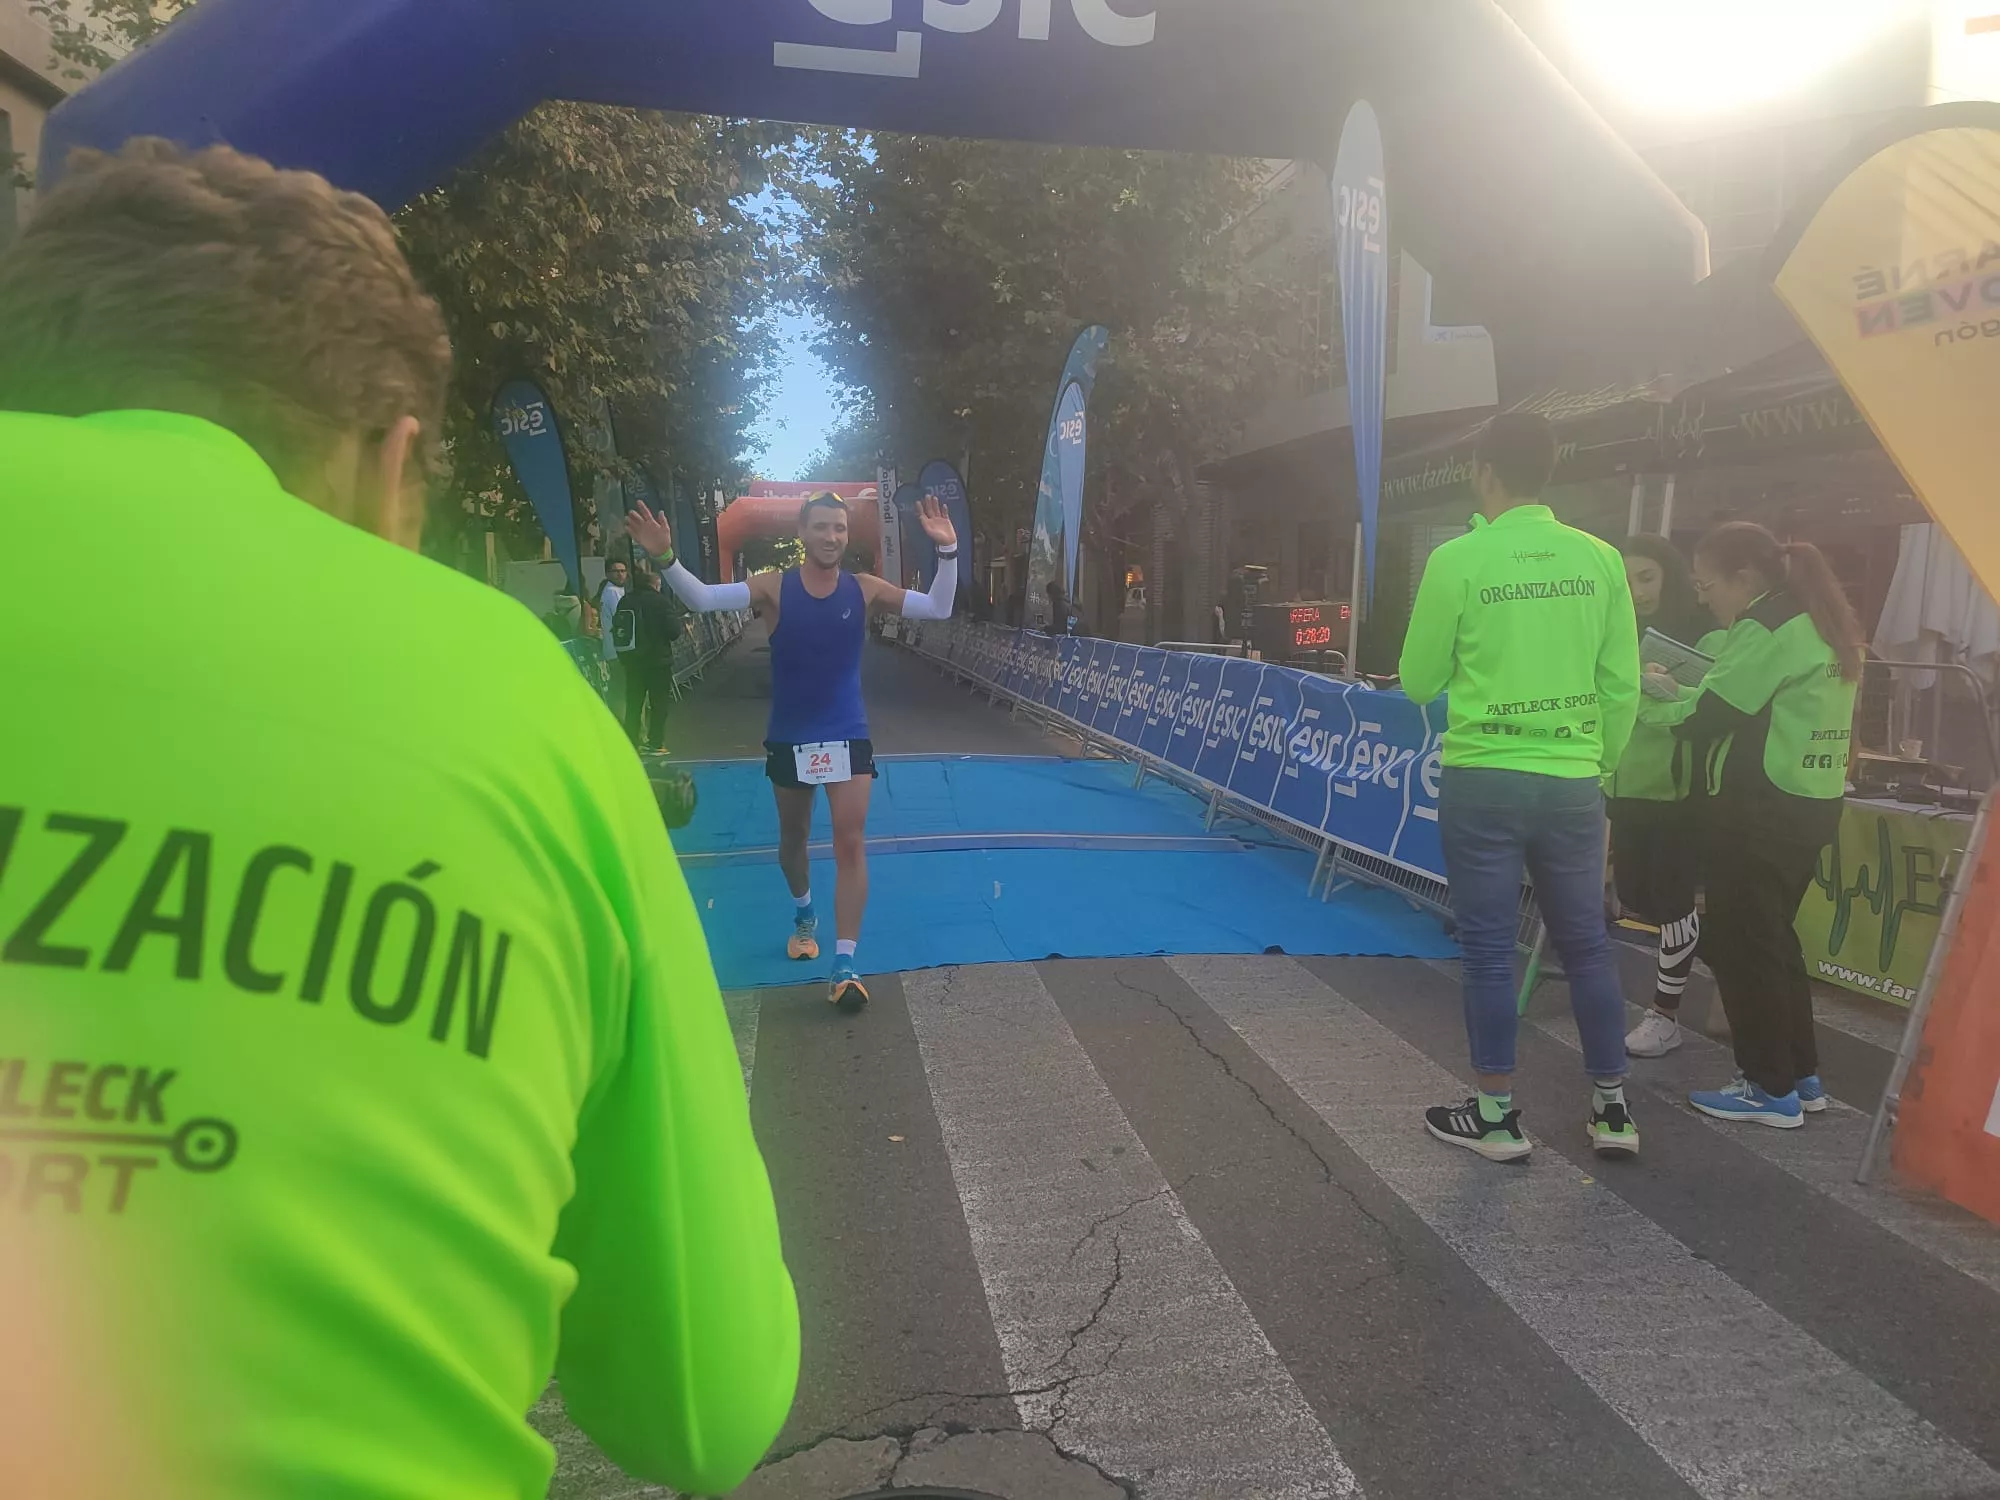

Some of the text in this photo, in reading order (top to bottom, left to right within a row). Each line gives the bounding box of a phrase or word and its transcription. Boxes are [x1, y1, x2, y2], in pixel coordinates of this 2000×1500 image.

[1480, 575, 1595, 604] ORGANIZACIÓN
[1486, 698, 1561, 716] FARTLECK
[810, 752, 832, 767] 24
[1289, 725, 1342, 771] esic
[1347, 739, 1415, 789] esic
